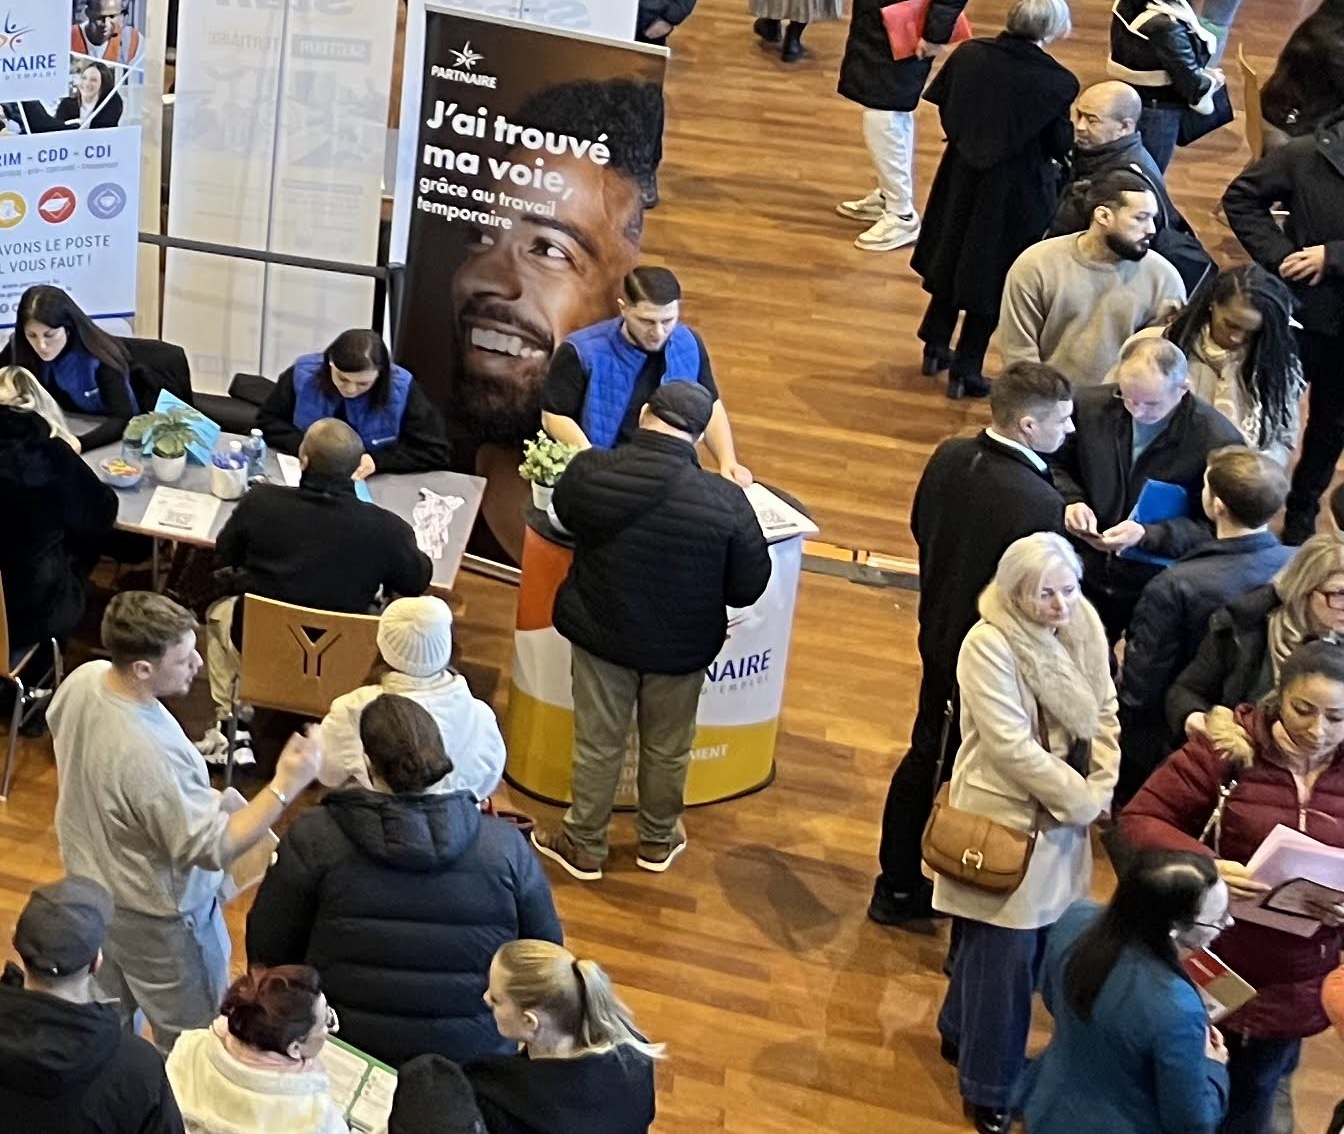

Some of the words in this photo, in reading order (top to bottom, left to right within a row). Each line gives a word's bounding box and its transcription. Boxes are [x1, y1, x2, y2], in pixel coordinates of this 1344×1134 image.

[431, 65, 497, 89] PARTNAIRE
[426, 100, 488, 138] J'ai
[494, 115, 611, 165] trouvé
[38, 147, 69, 163] CDD
[84, 145, 111, 159] CDI
[423, 144, 480, 176] ma
[488, 158, 575, 200] voie,
[417, 196, 513, 230] temporaire
[419, 177, 468, 199] grâce
[472, 188, 495, 203] au
[499, 192, 556, 217] travail
[46, 238, 61, 252] LE
[66, 235, 111, 250] POSTE
[9, 259, 46, 273] VOUS
[50, 254, 84, 269] FAUT
[707, 648, 772, 683] NAIRE
